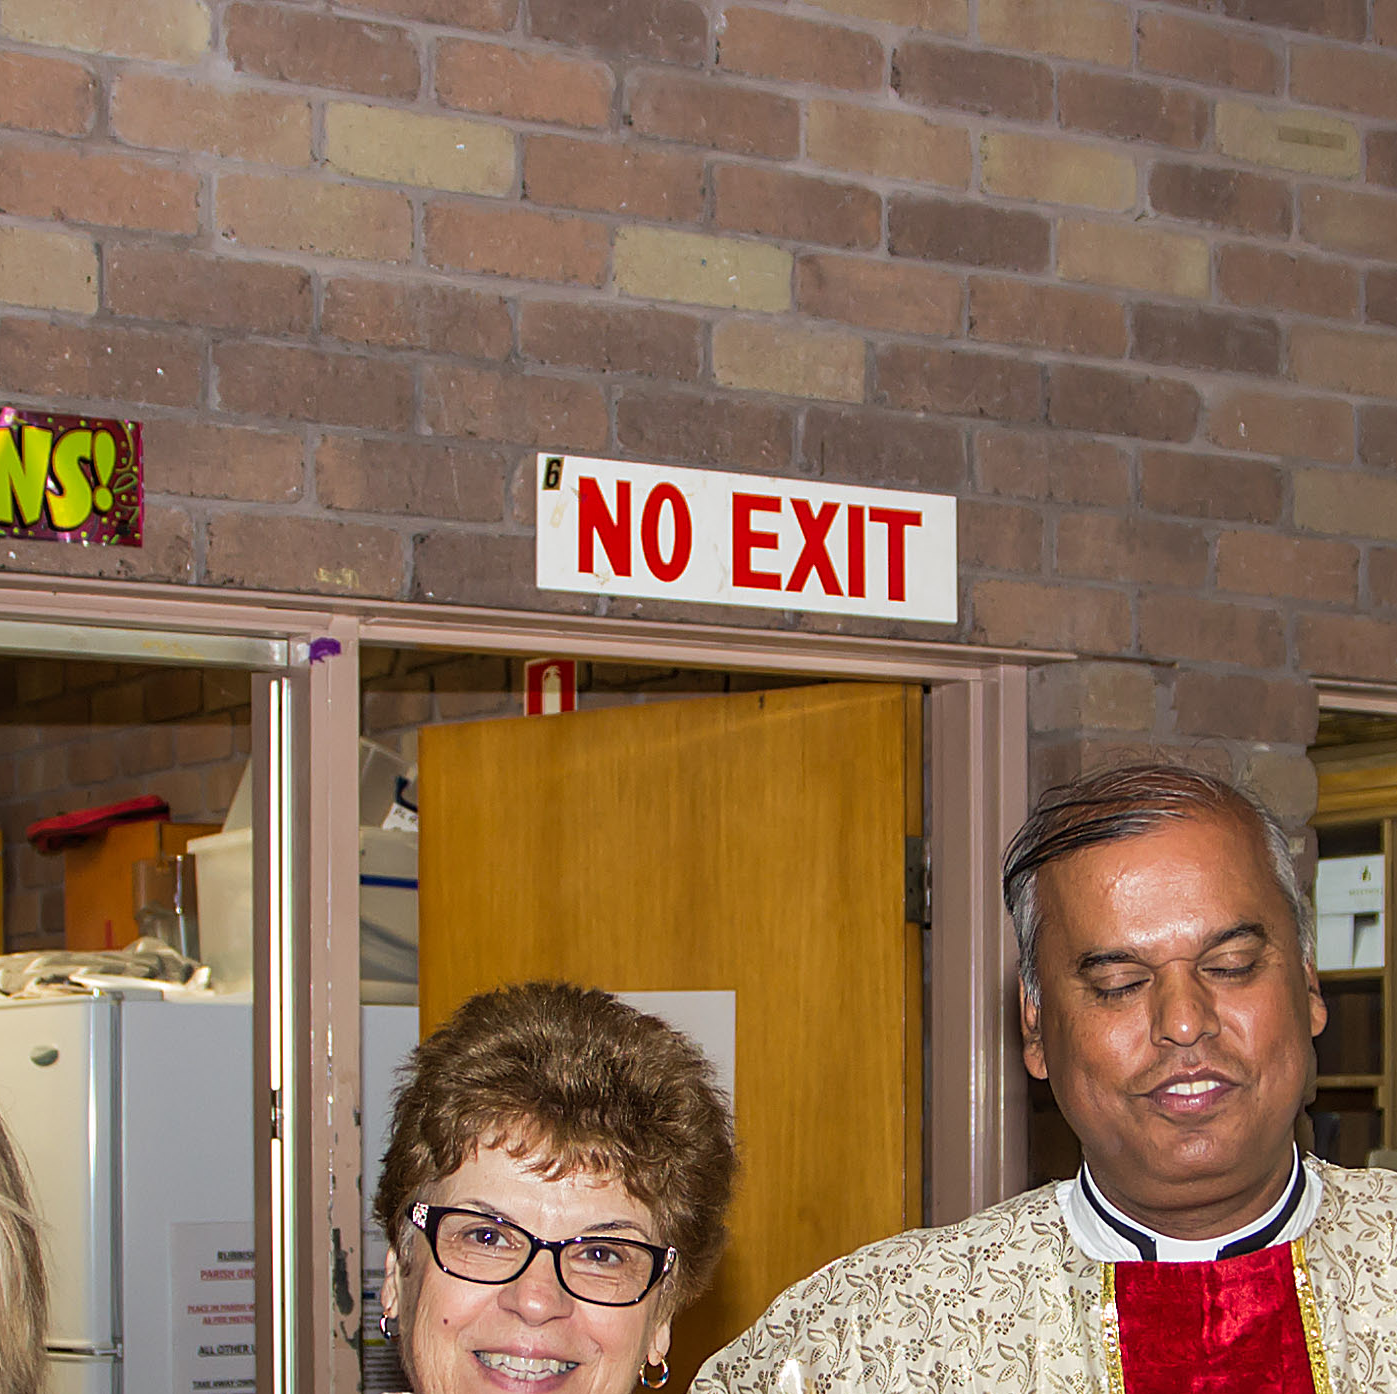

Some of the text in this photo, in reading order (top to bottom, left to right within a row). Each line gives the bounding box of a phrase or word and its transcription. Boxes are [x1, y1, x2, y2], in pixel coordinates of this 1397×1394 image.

[546, 459, 561, 488] 6
[577, 475, 923, 602] NO EXIT
